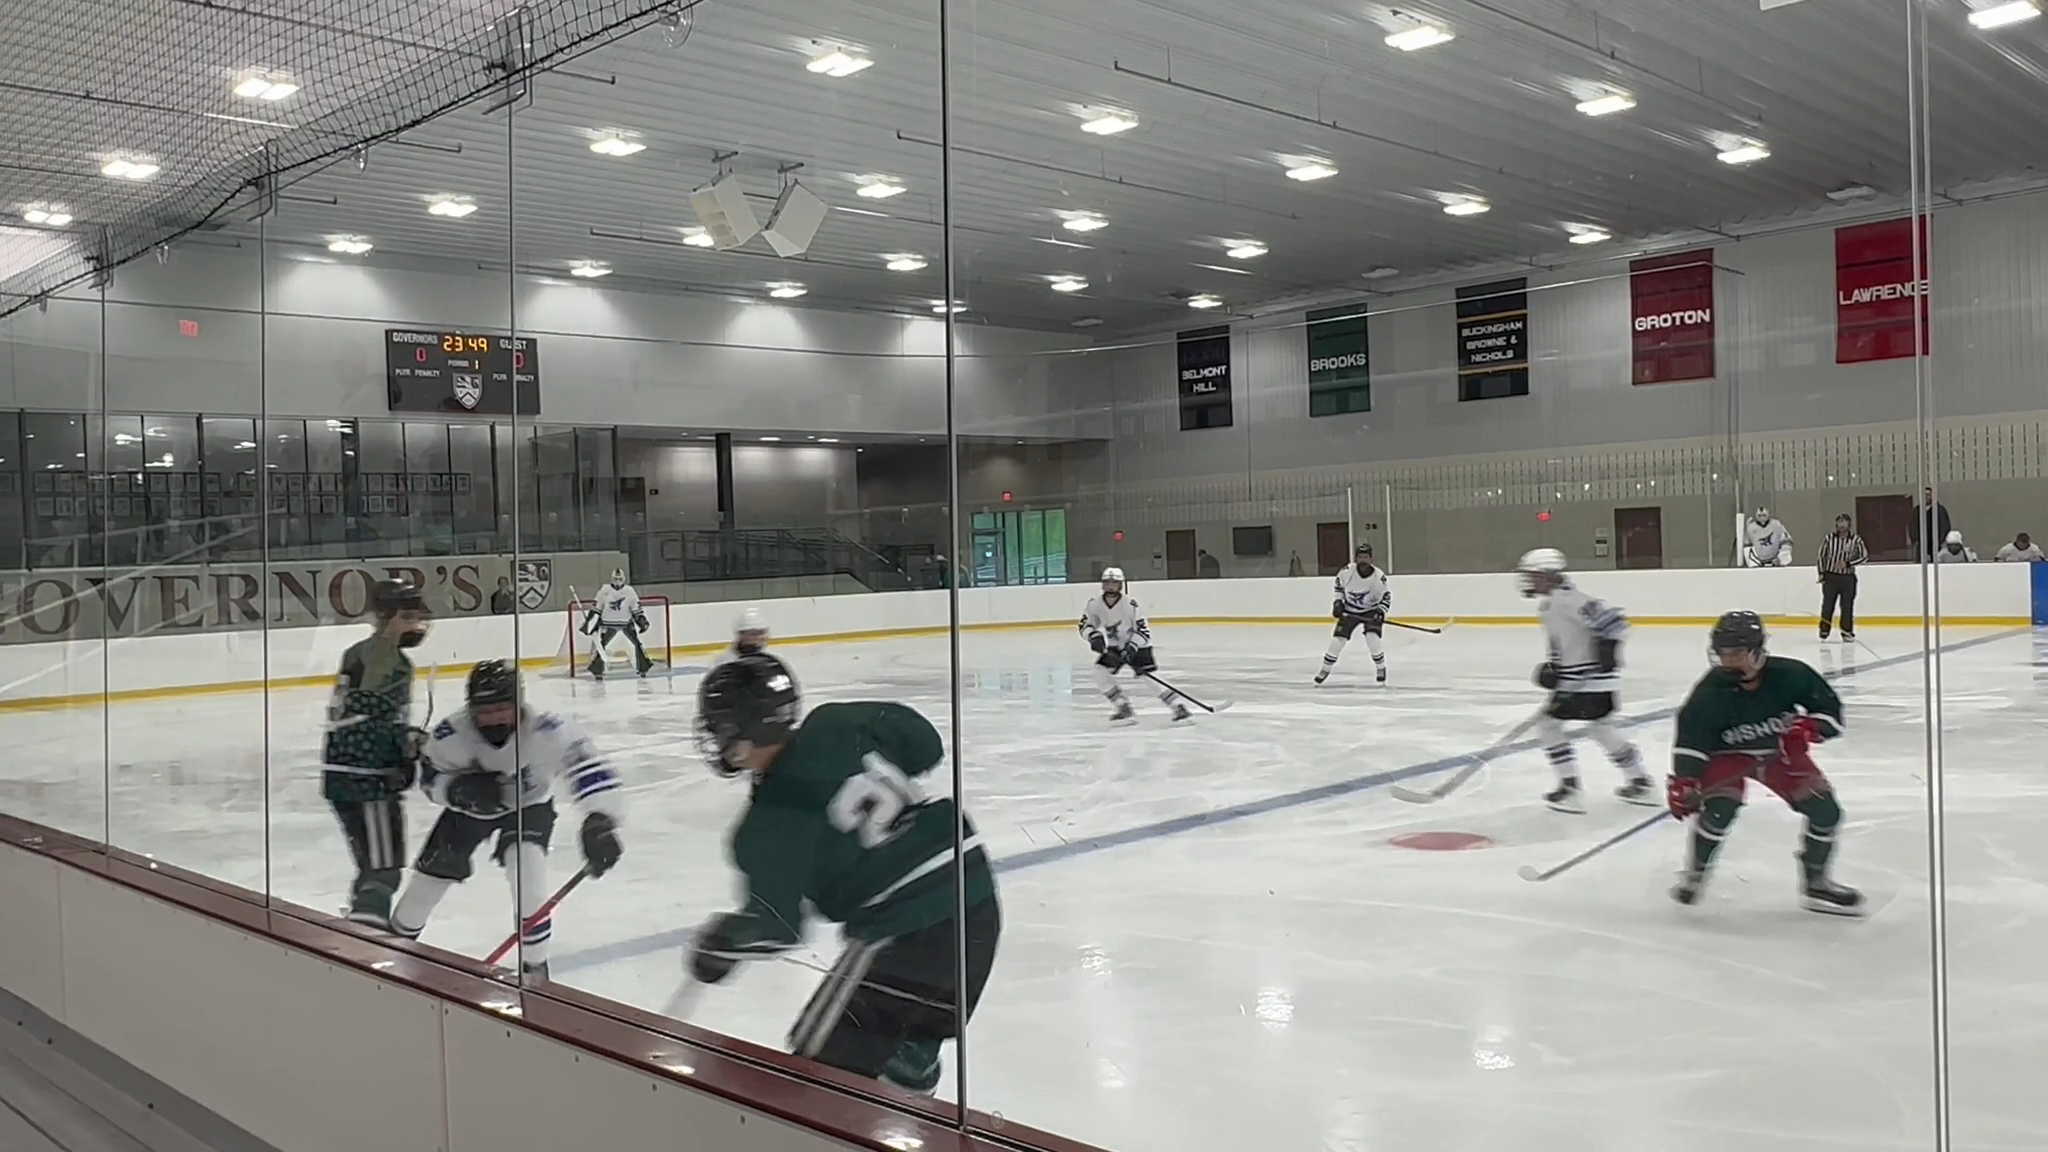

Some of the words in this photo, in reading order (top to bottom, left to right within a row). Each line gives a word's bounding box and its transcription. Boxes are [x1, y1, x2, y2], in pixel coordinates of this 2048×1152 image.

[1839, 279, 1929, 305] LAWRENCE
[1634, 308, 1711, 331] GROTON
[1461, 320, 1523, 337] BUCKINGHAM
[393, 332, 438, 345] GOVERNORS
[499, 338, 528, 350] GUST
[1466, 336, 1507, 350] BROWNE
[416, 347, 427, 363] 0
[1310, 353, 1367, 371] BROOKS
[1471, 350, 1514, 363] NICHOLS
[414, 369, 440, 378] PENALTY
[1181, 365, 1228, 380] BELMONT
[1192, 381, 1217, 393] HILL
[0, 564, 483, 636] OVERNOR'S
